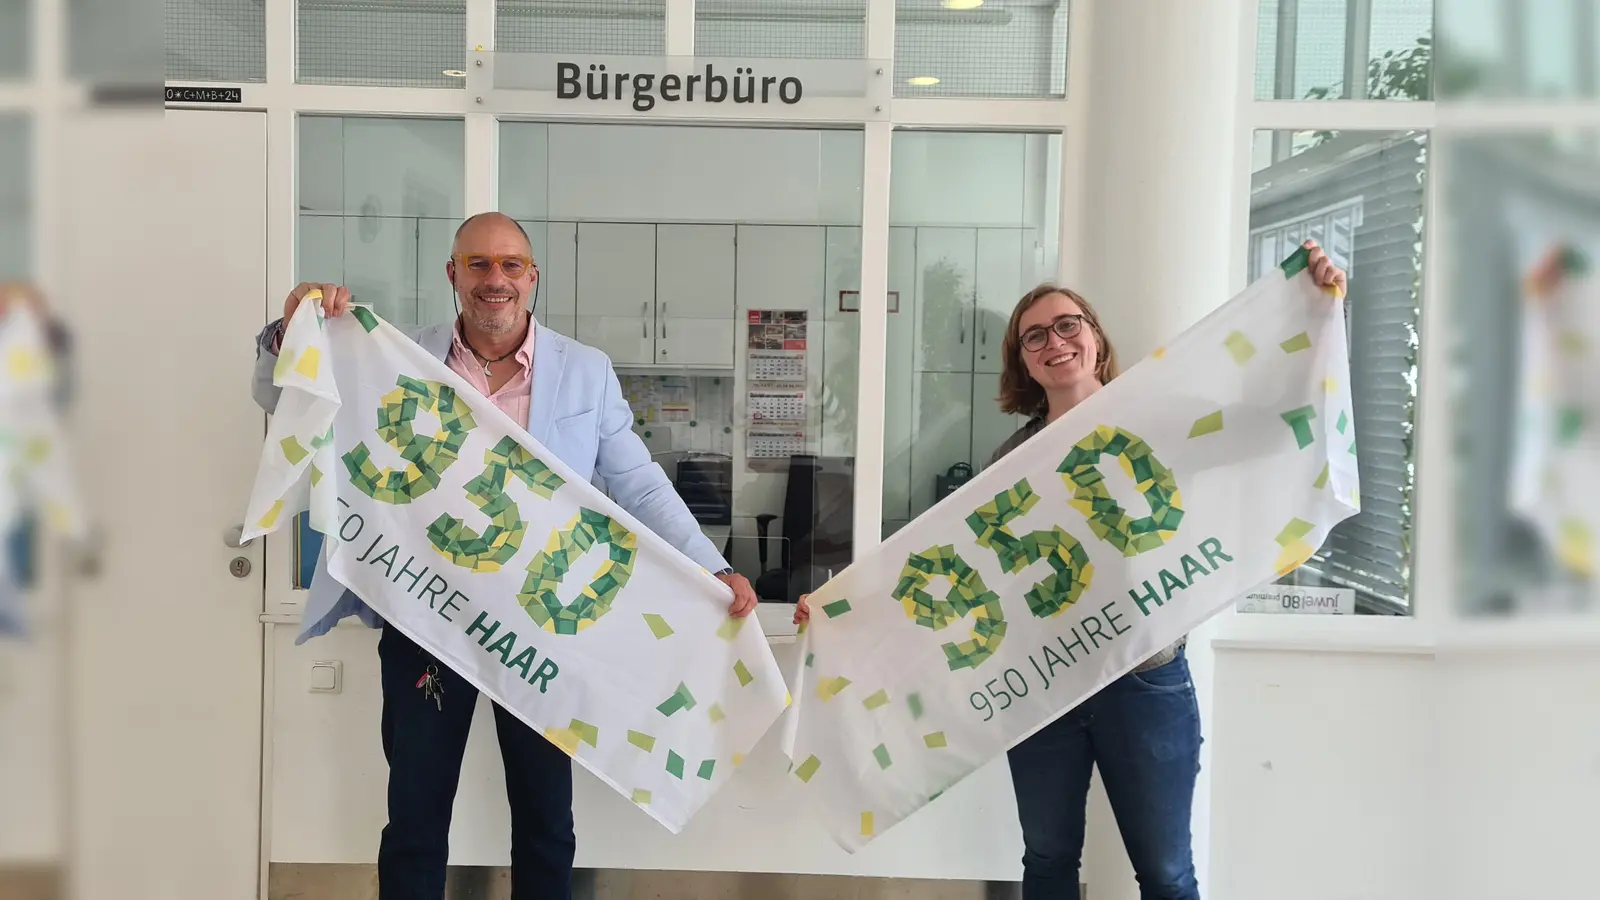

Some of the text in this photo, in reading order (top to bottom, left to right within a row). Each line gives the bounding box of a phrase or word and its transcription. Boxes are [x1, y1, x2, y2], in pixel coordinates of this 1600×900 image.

[555, 62, 803, 111] Bürgerbüro
[341, 374, 638, 635] 950
[891, 423, 1185, 671] 950
[356, 534, 469, 622] JAHRE
[465, 610, 559, 694] HAAR
[969, 537, 1234, 722] 950 JAHRE HAAR
